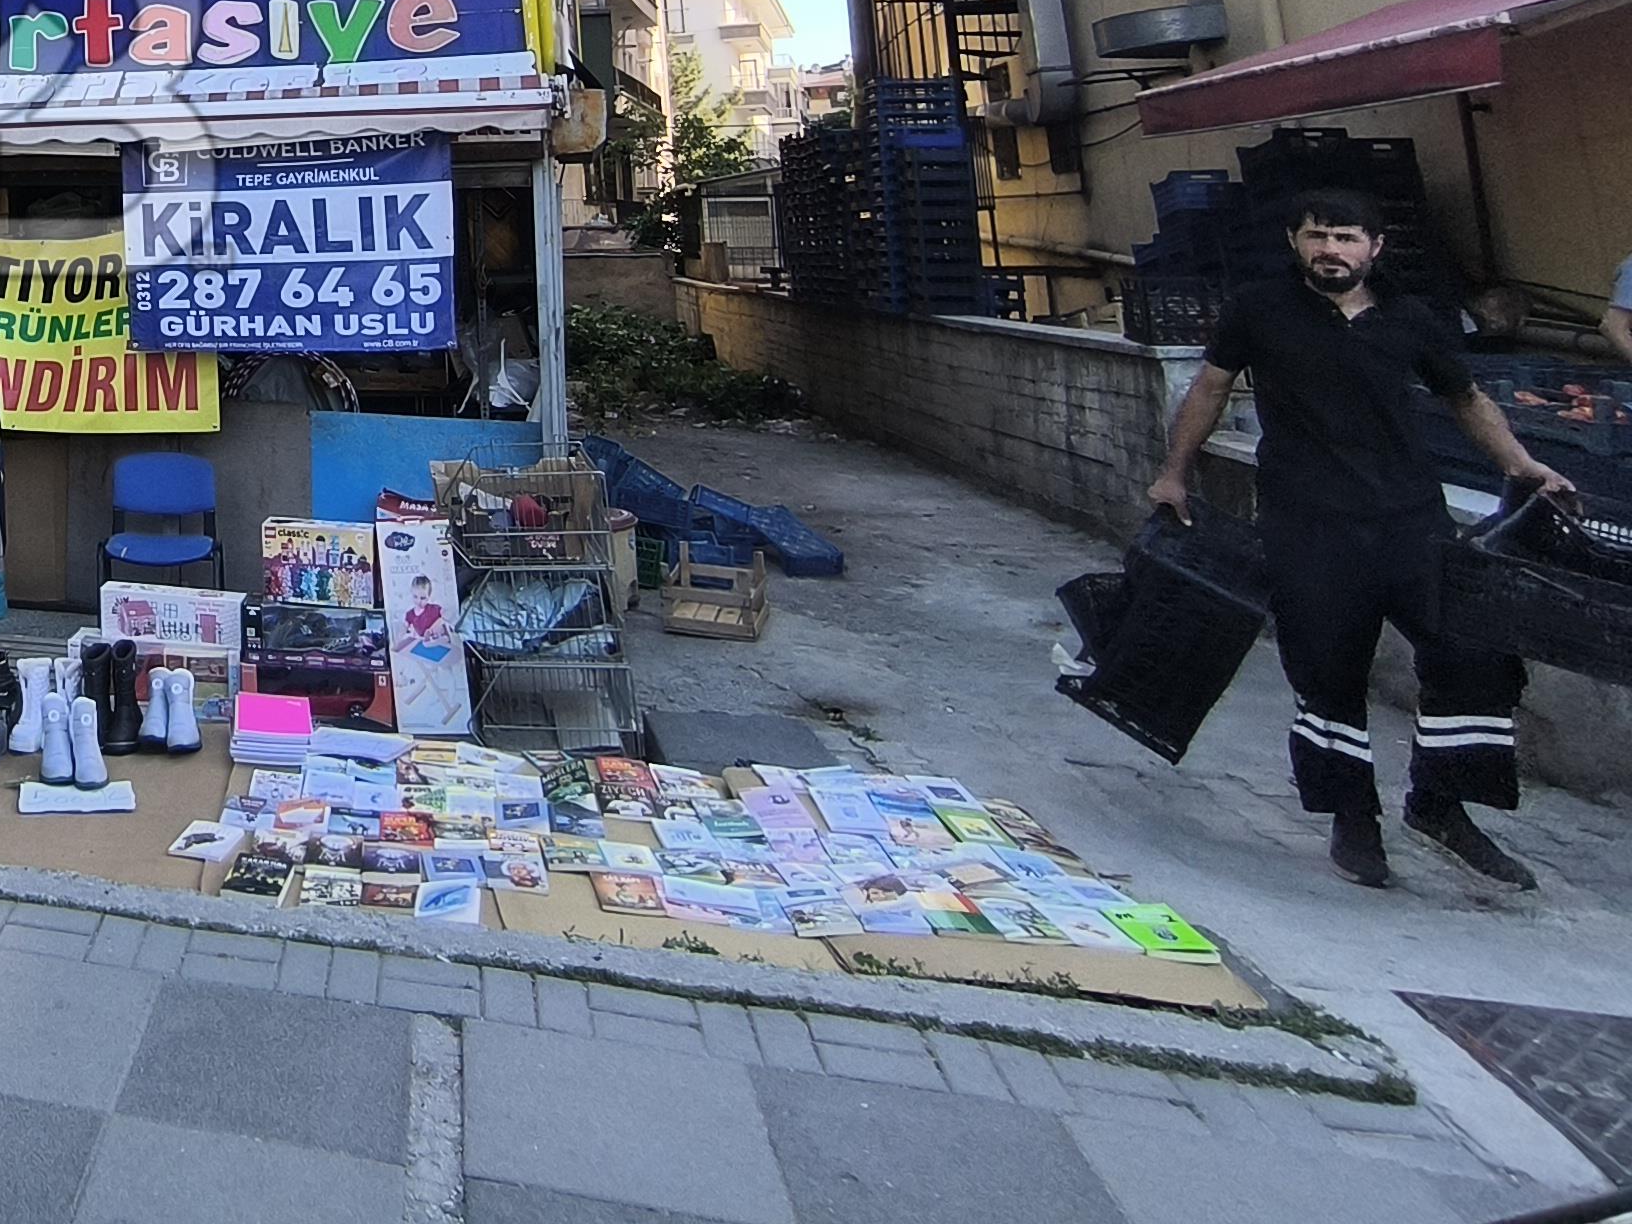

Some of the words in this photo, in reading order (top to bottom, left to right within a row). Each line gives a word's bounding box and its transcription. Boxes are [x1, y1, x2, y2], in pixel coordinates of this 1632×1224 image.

[196, 139, 322, 160] COLDWELL
[330, 131, 426, 155] BANKER
[236, 174, 271, 187] TEPE
[276, 167, 380, 186] GAYRİMENKUL
[137, 271, 152, 311] 0312
[157, 268, 262, 310] 287
[280, 266, 355, 309] 64
[371, 263, 442, 307] 65
[159, 310, 322, 337] GÜRHAN
[334, 311, 436, 335] USLU
